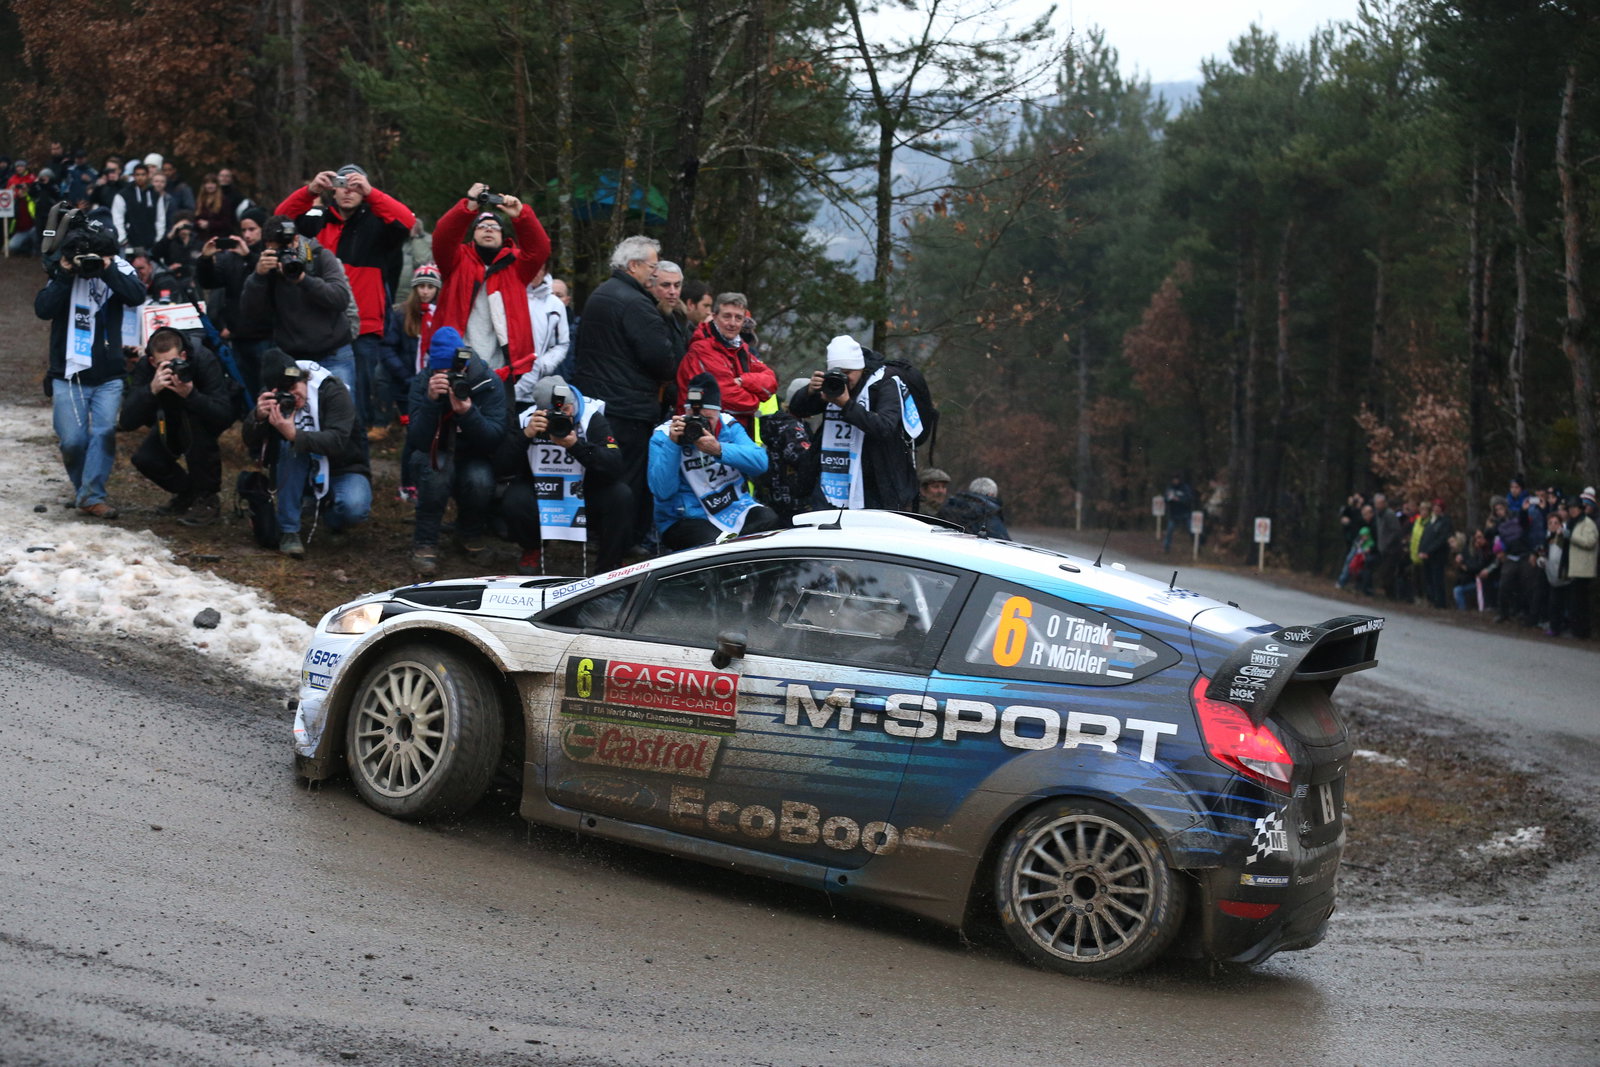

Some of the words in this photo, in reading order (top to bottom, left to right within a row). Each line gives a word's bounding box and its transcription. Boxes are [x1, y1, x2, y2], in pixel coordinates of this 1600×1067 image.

[540, 448, 574, 465] 228
[489, 594, 534, 607] PULSAR
[552, 578, 596, 599] sparco
[991, 595, 1033, 667] 6
[1046, 614, 1061, 638] O
[1065, 616, 1112, 647] Tänak
[1284, 631, 1310, 642] SWP
[1029, 641, 1045, 665] R
[1047, 644, 1107, 675] Mõlder
[576, 658, 594, 698] 6
[610, 664, 735, 699] CASINO
[609, 687, 629, 701] DE
[631, 691, 733, 713] MONTE-CARLO
[1230, 687, 1256, 700] NGK
[606, 707, 627, 717] World
[627, 710, 645, 720] Rally
[645, 711, 694, 726] Championship
[784, 683, 1179, 764] M-SPORT
[597, 728, 709, 772] Castrol
